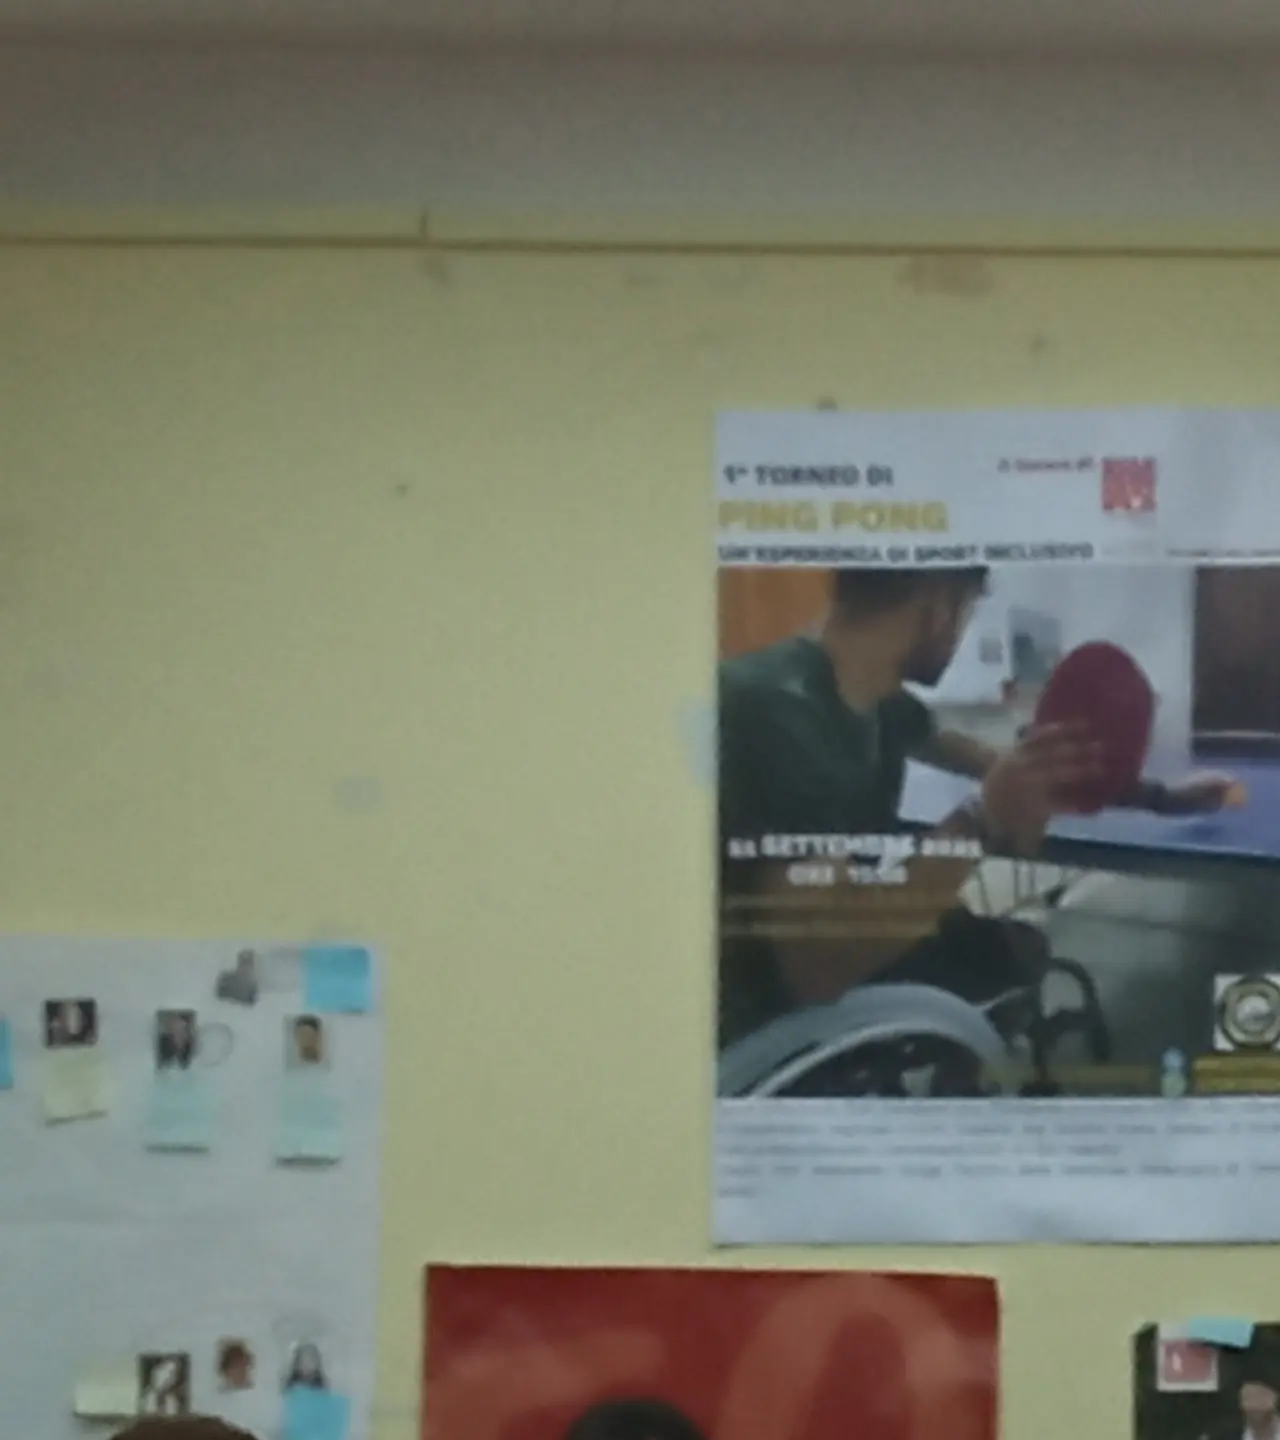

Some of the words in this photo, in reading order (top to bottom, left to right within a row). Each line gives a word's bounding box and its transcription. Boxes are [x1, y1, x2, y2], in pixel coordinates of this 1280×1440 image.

[754, 464, 861, 488] TORNEO
[866, 464, 894, 487] DI
[718, 501, 819, 534] PING
[832, 501, 949, 534] PONG
[913, 543, 977, 562] SPORT
[985, 542, 1094, 562] INCLUSIVO
